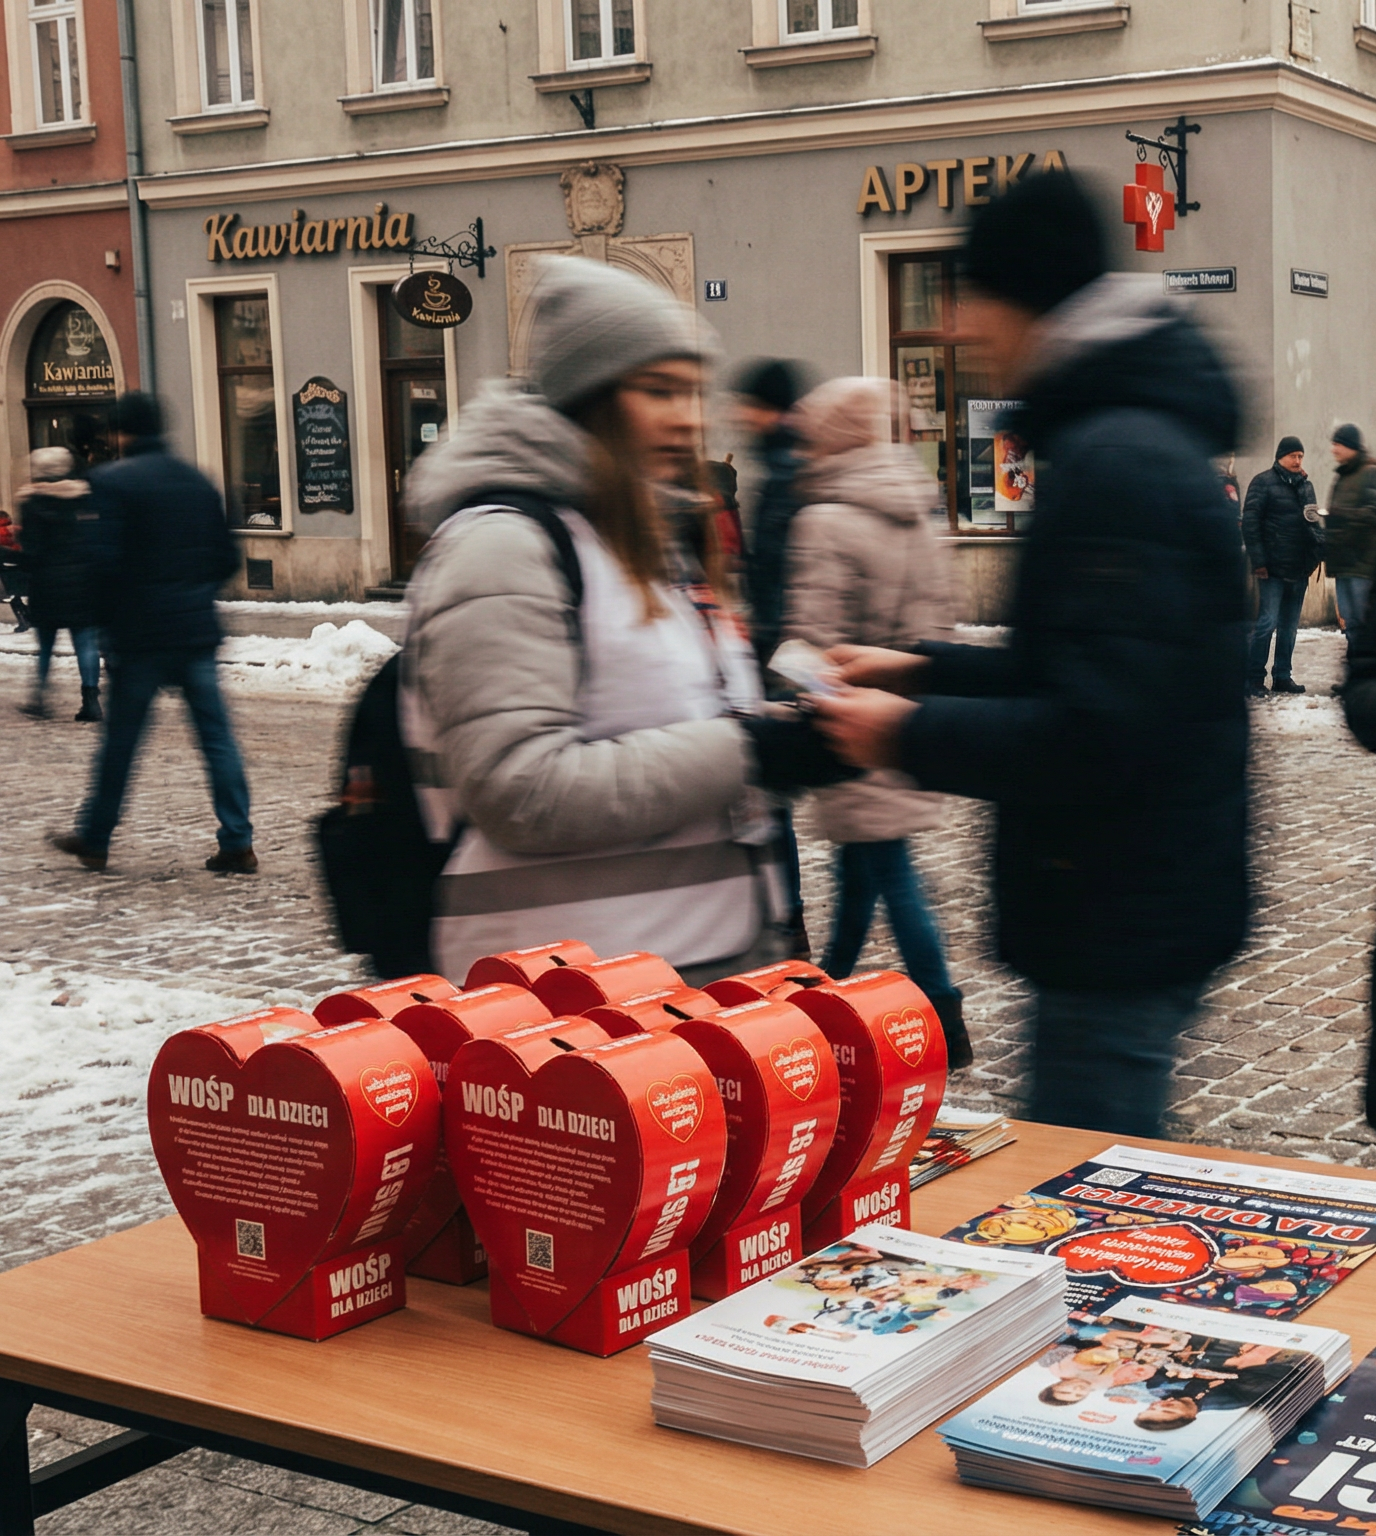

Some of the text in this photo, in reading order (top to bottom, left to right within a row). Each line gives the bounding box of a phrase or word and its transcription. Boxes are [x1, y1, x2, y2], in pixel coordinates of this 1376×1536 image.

[203, 202, 413, 261] Kawiarnia
[168, 1074, 329, 1128] WOŚP DLA DZIECI
[461, 1081, 616, 1142] WOŚP DLA DZIECI
[854, 1181, 900, 1222] WOŚP
[739, 1221, 790, 1264] WOŚP
[1275, 1215, 1371, 1242] DLA
[329, 1252, 391, 1298] WOŚP
[617, 1267, 677, 1314] WOŚP
[740, 1263, 760, 1283] DLA
[331, 1297, 354, 1318] DLA
[619, 1312, 641, 1334] DLA
